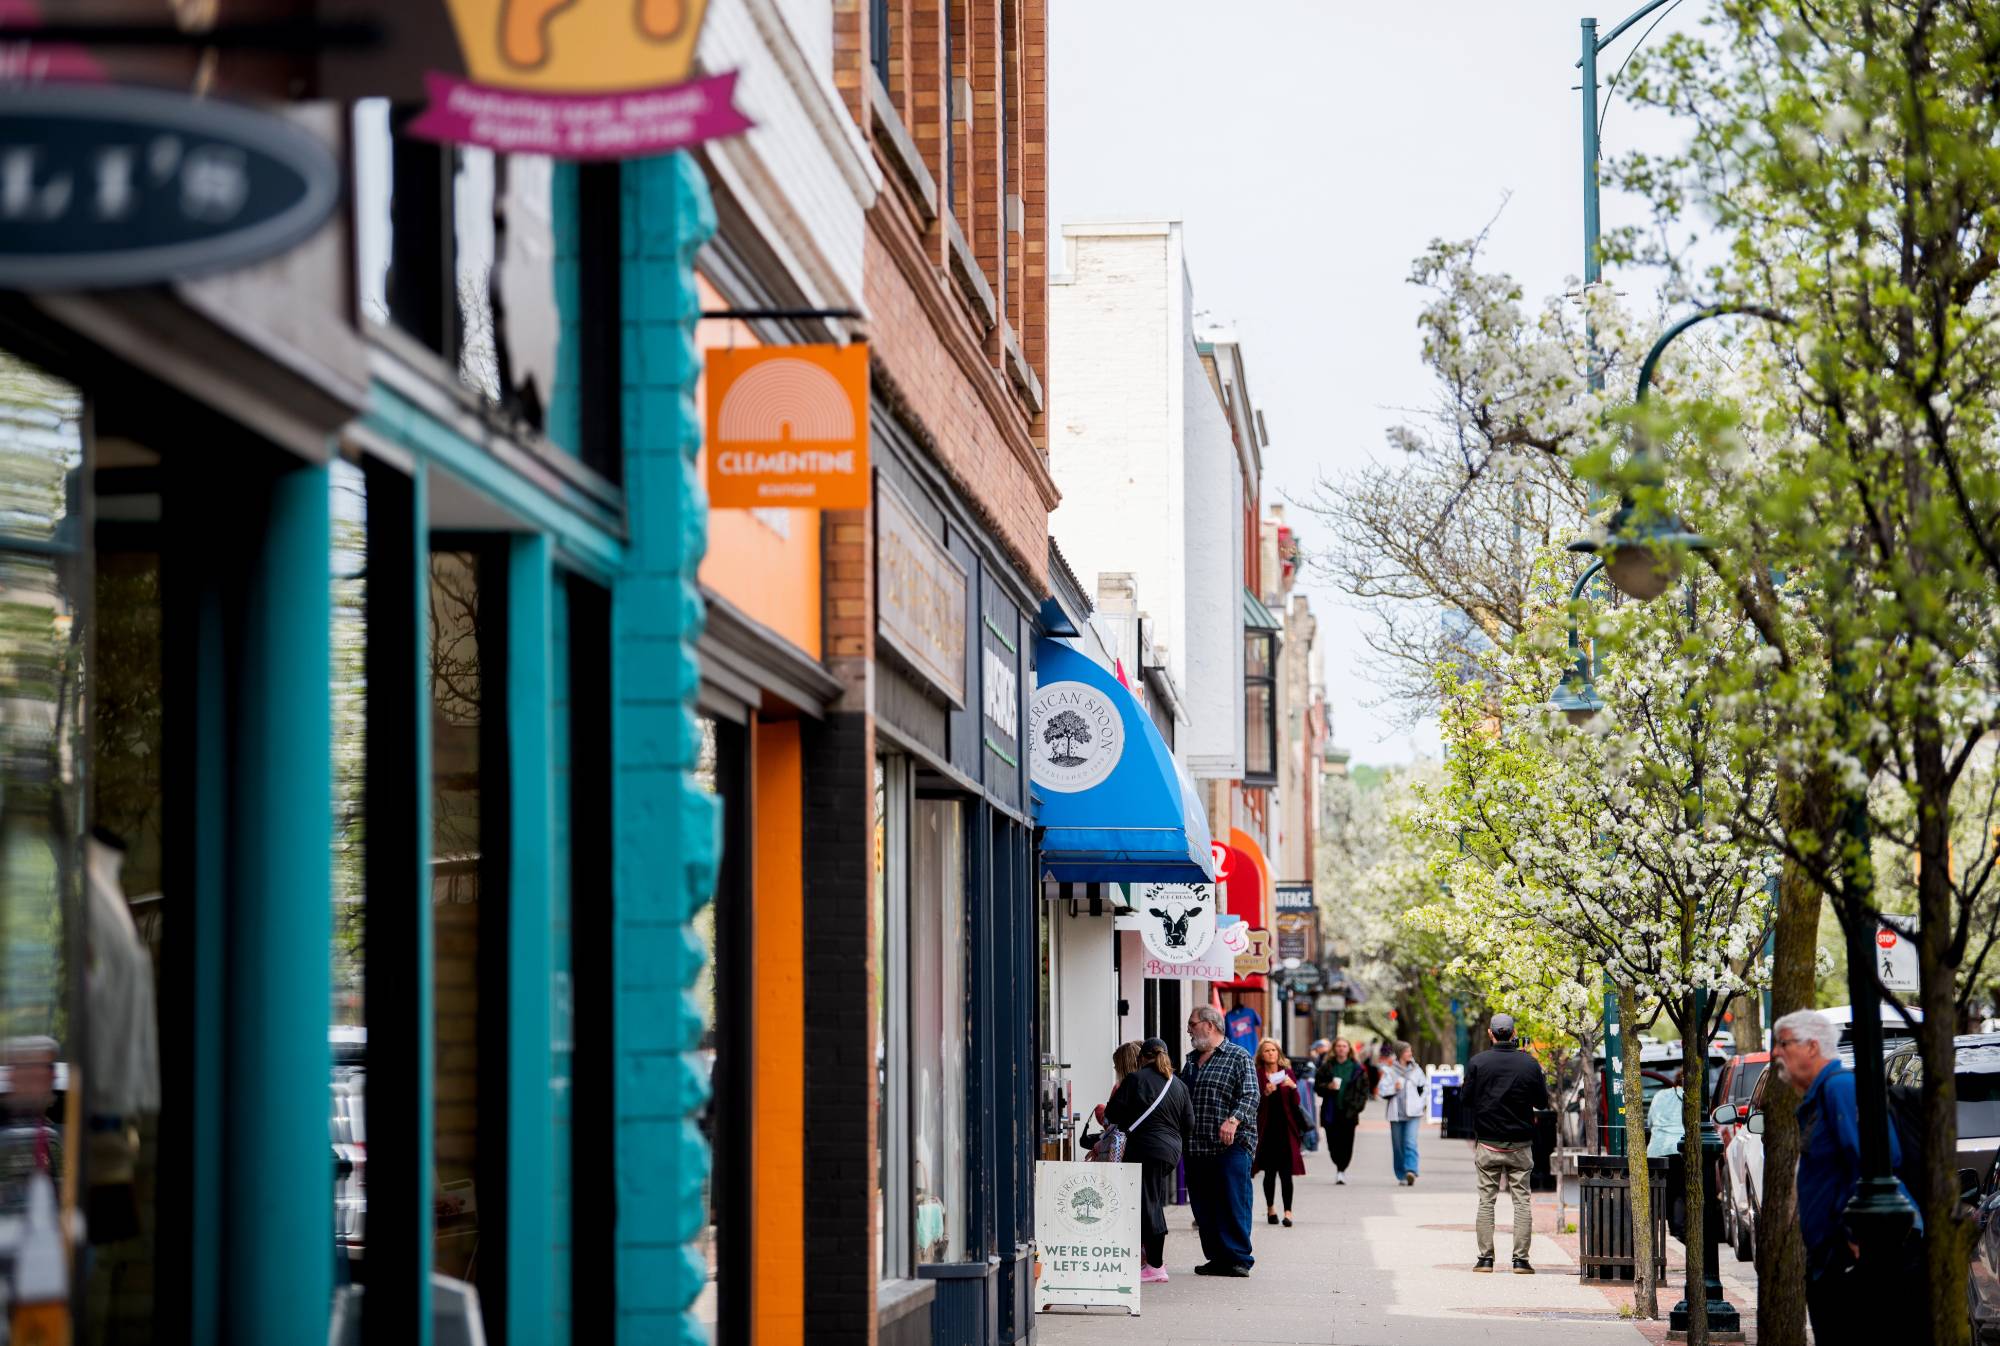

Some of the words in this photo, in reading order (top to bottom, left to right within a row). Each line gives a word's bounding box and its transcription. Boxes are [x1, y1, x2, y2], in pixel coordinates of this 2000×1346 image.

[717, 450, 855, 476] CLEMENTINE
[1084, 698, 1114, 755] SPOON
[1878, 934, 1895, 945] STOP
[1147, 960, 1225, 978] BOUTIQUE
[1056, 1175, 1098, 1216] AMERICAN
[1045, 1246, 1088, 1257] WE'RE
[1091, 1246, 1132, 1258] OPEN
[1053, 1261, 1090, 1272] LET'S
[1092, 1262, 1122, 1273] JAM
